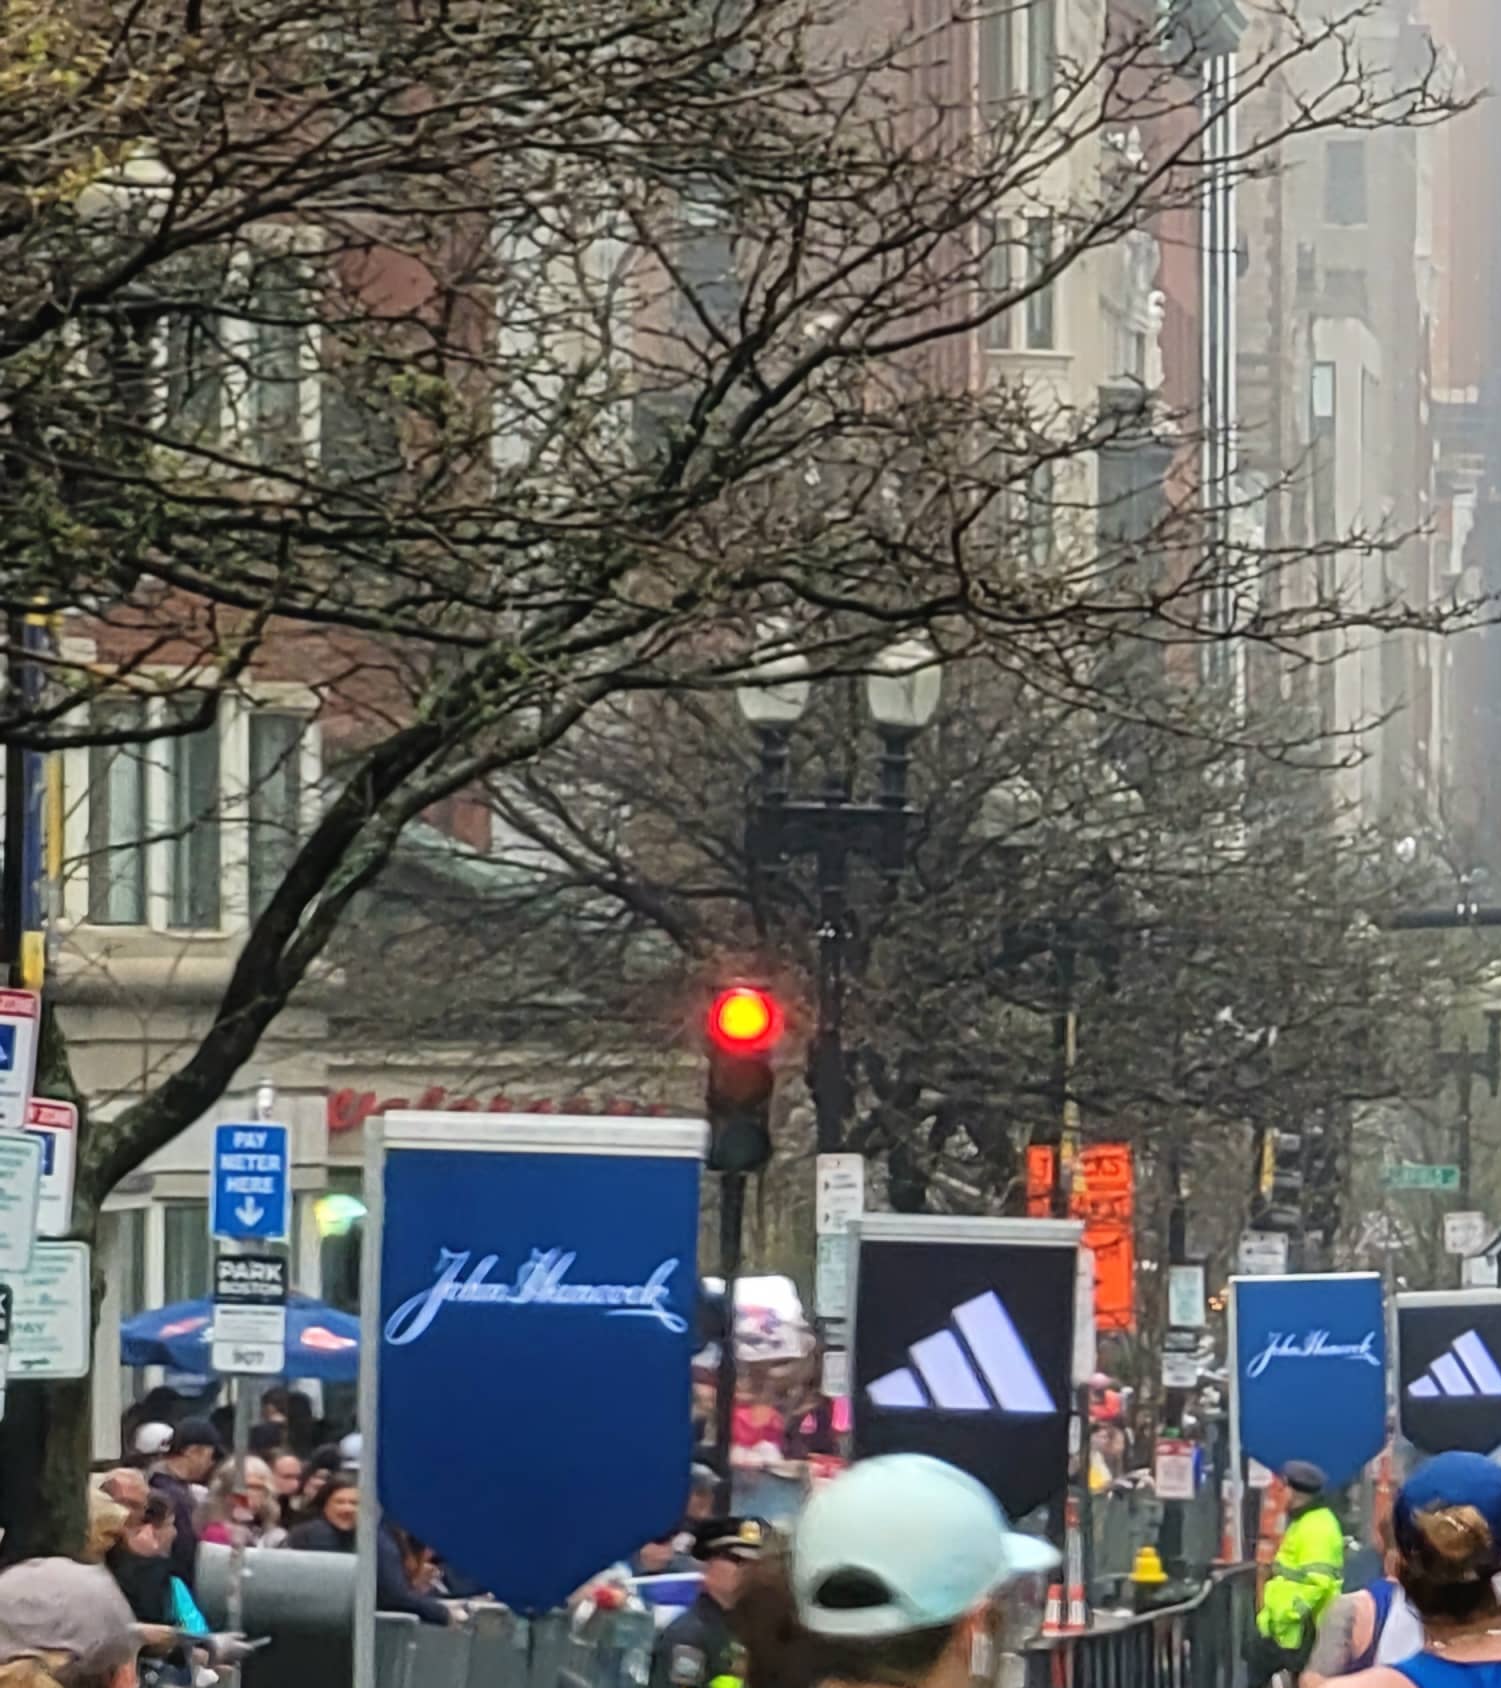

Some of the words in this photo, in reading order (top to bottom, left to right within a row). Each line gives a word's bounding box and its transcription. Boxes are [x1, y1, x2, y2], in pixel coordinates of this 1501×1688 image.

[232, 1131, 268, 1149] PAY
[220, 1153, 281, 1172] METER
[225, 1175, 275, 1194] HERE
[217, 1260, 283, 1282] PARK
[384, 1246, 516, 1346] John
[512, 1246, 690, 1335] Hancock
